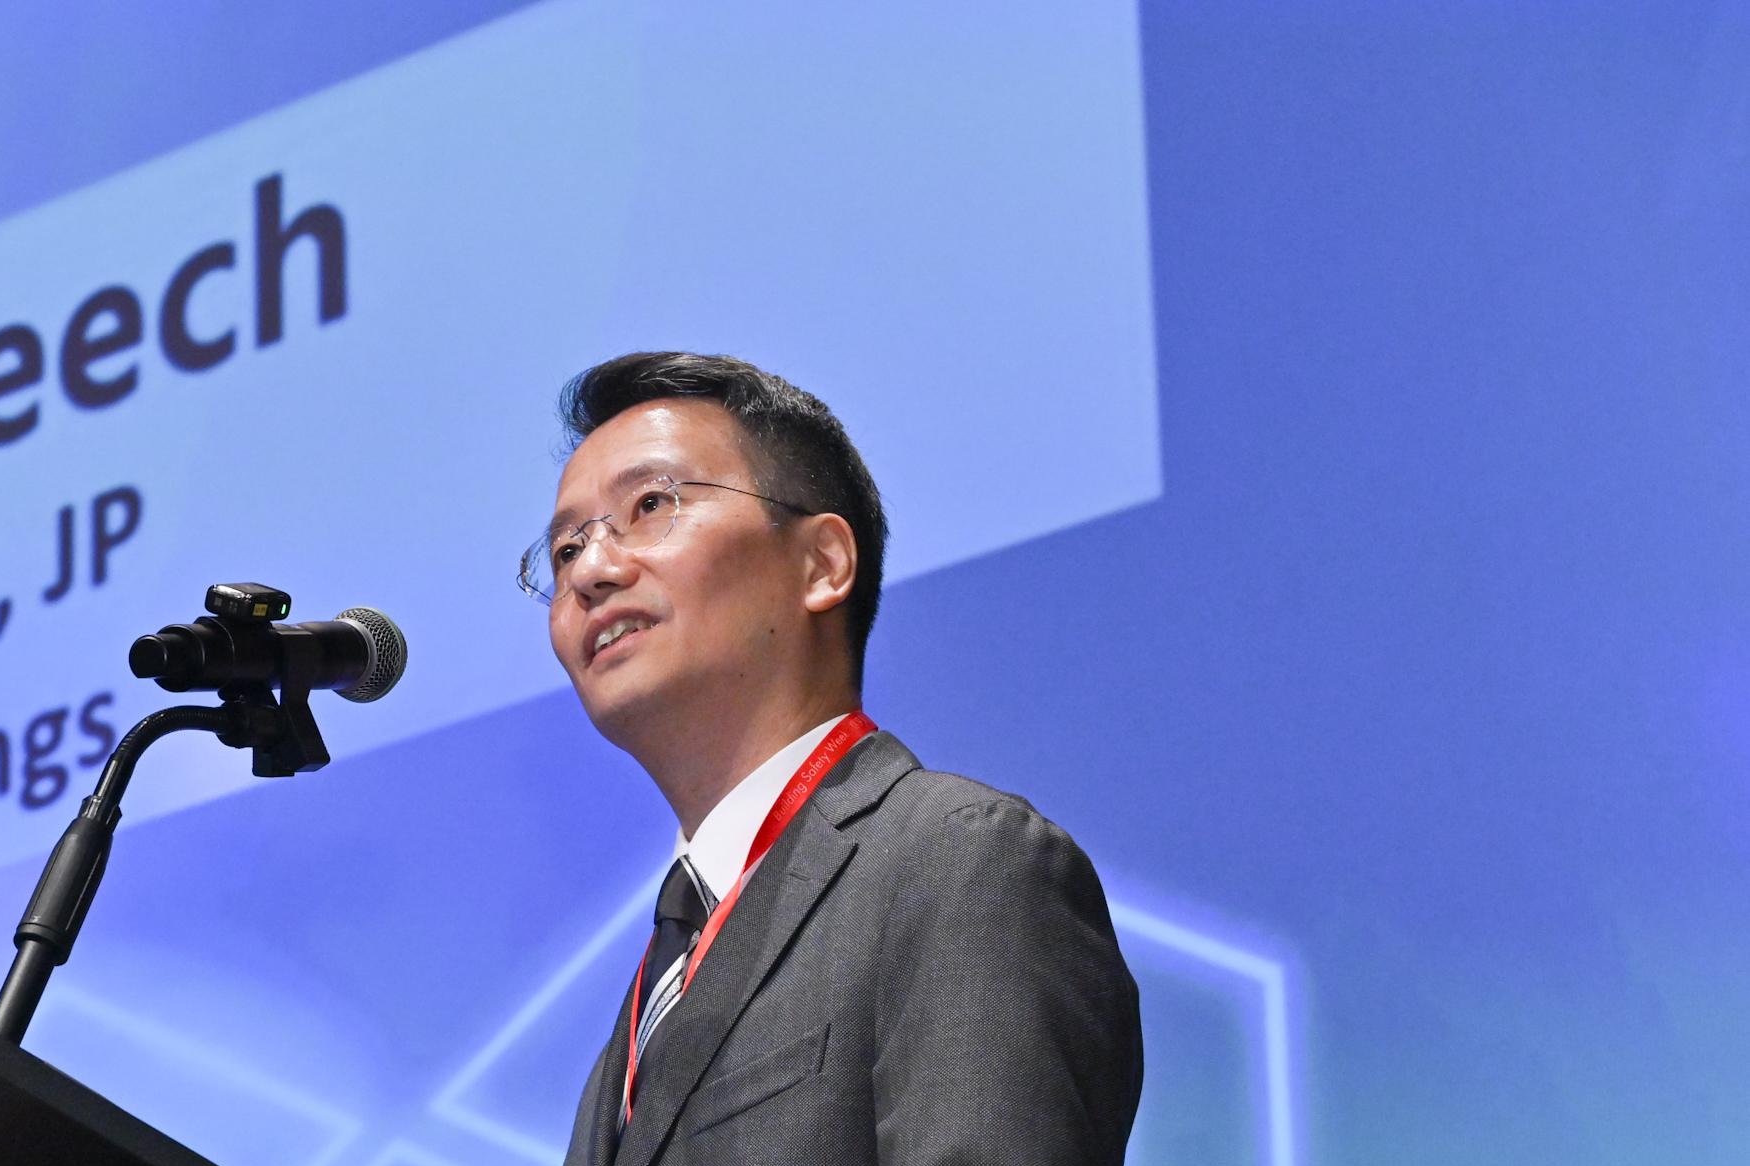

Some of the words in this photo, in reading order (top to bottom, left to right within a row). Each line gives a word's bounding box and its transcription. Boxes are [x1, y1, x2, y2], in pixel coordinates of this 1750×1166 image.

[41, 485, 143, 605] JP
[772, 781, 808, 822] Building
[801, 752, 831, 783] Safety
